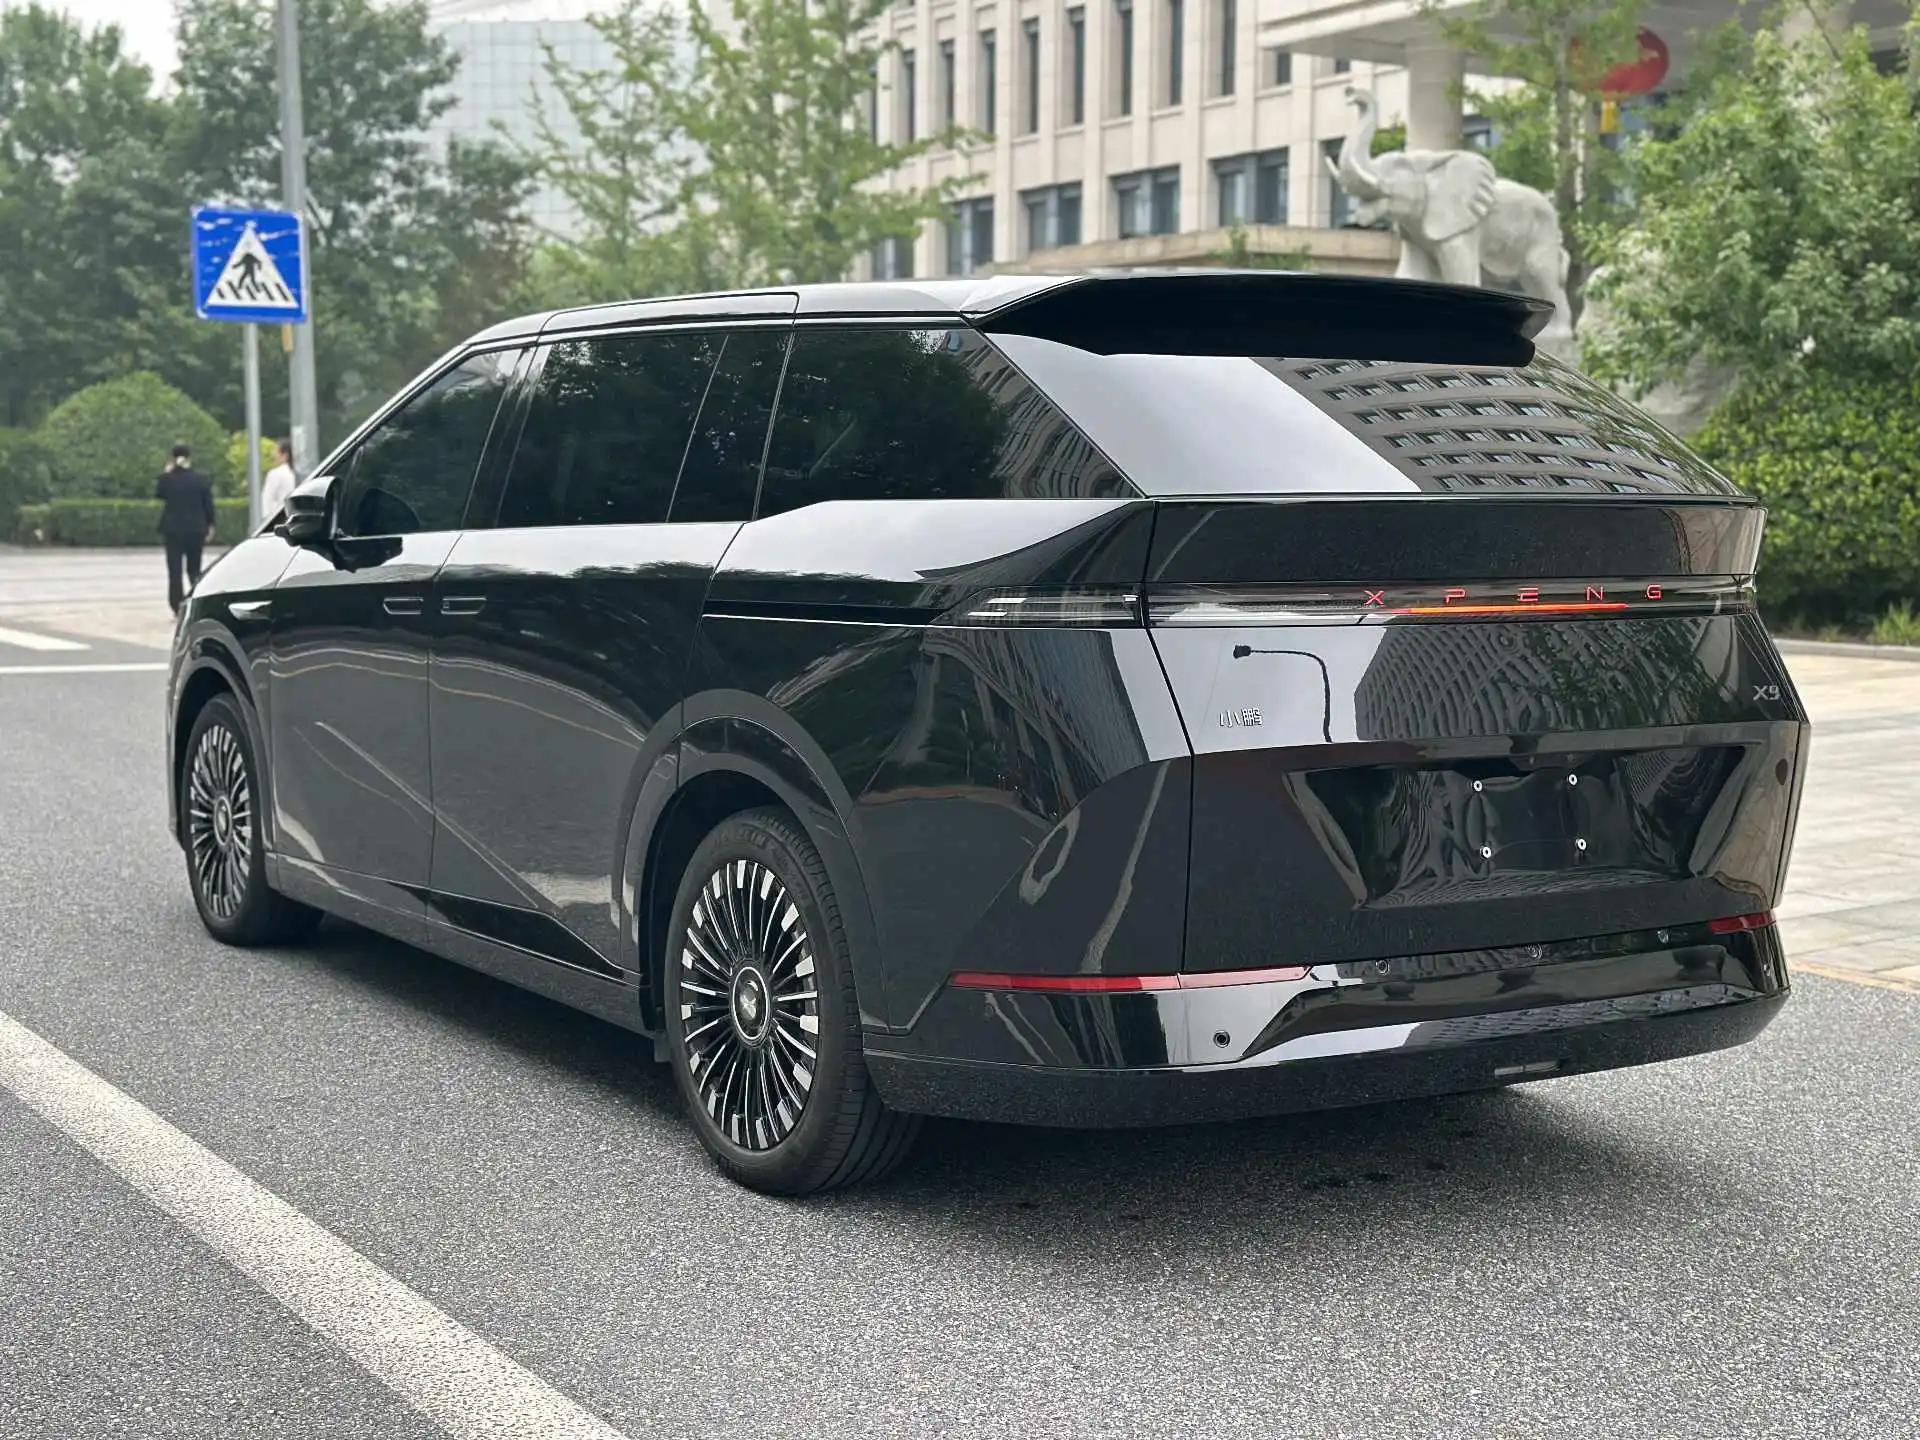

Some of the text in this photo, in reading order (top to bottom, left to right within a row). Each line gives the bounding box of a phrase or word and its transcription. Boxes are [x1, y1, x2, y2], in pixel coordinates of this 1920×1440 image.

[1364, 583, 1661, 606] XPENG
[1752, 685, 1780, 700] X9
[1219, 707, 1262, 728] 小鹏
